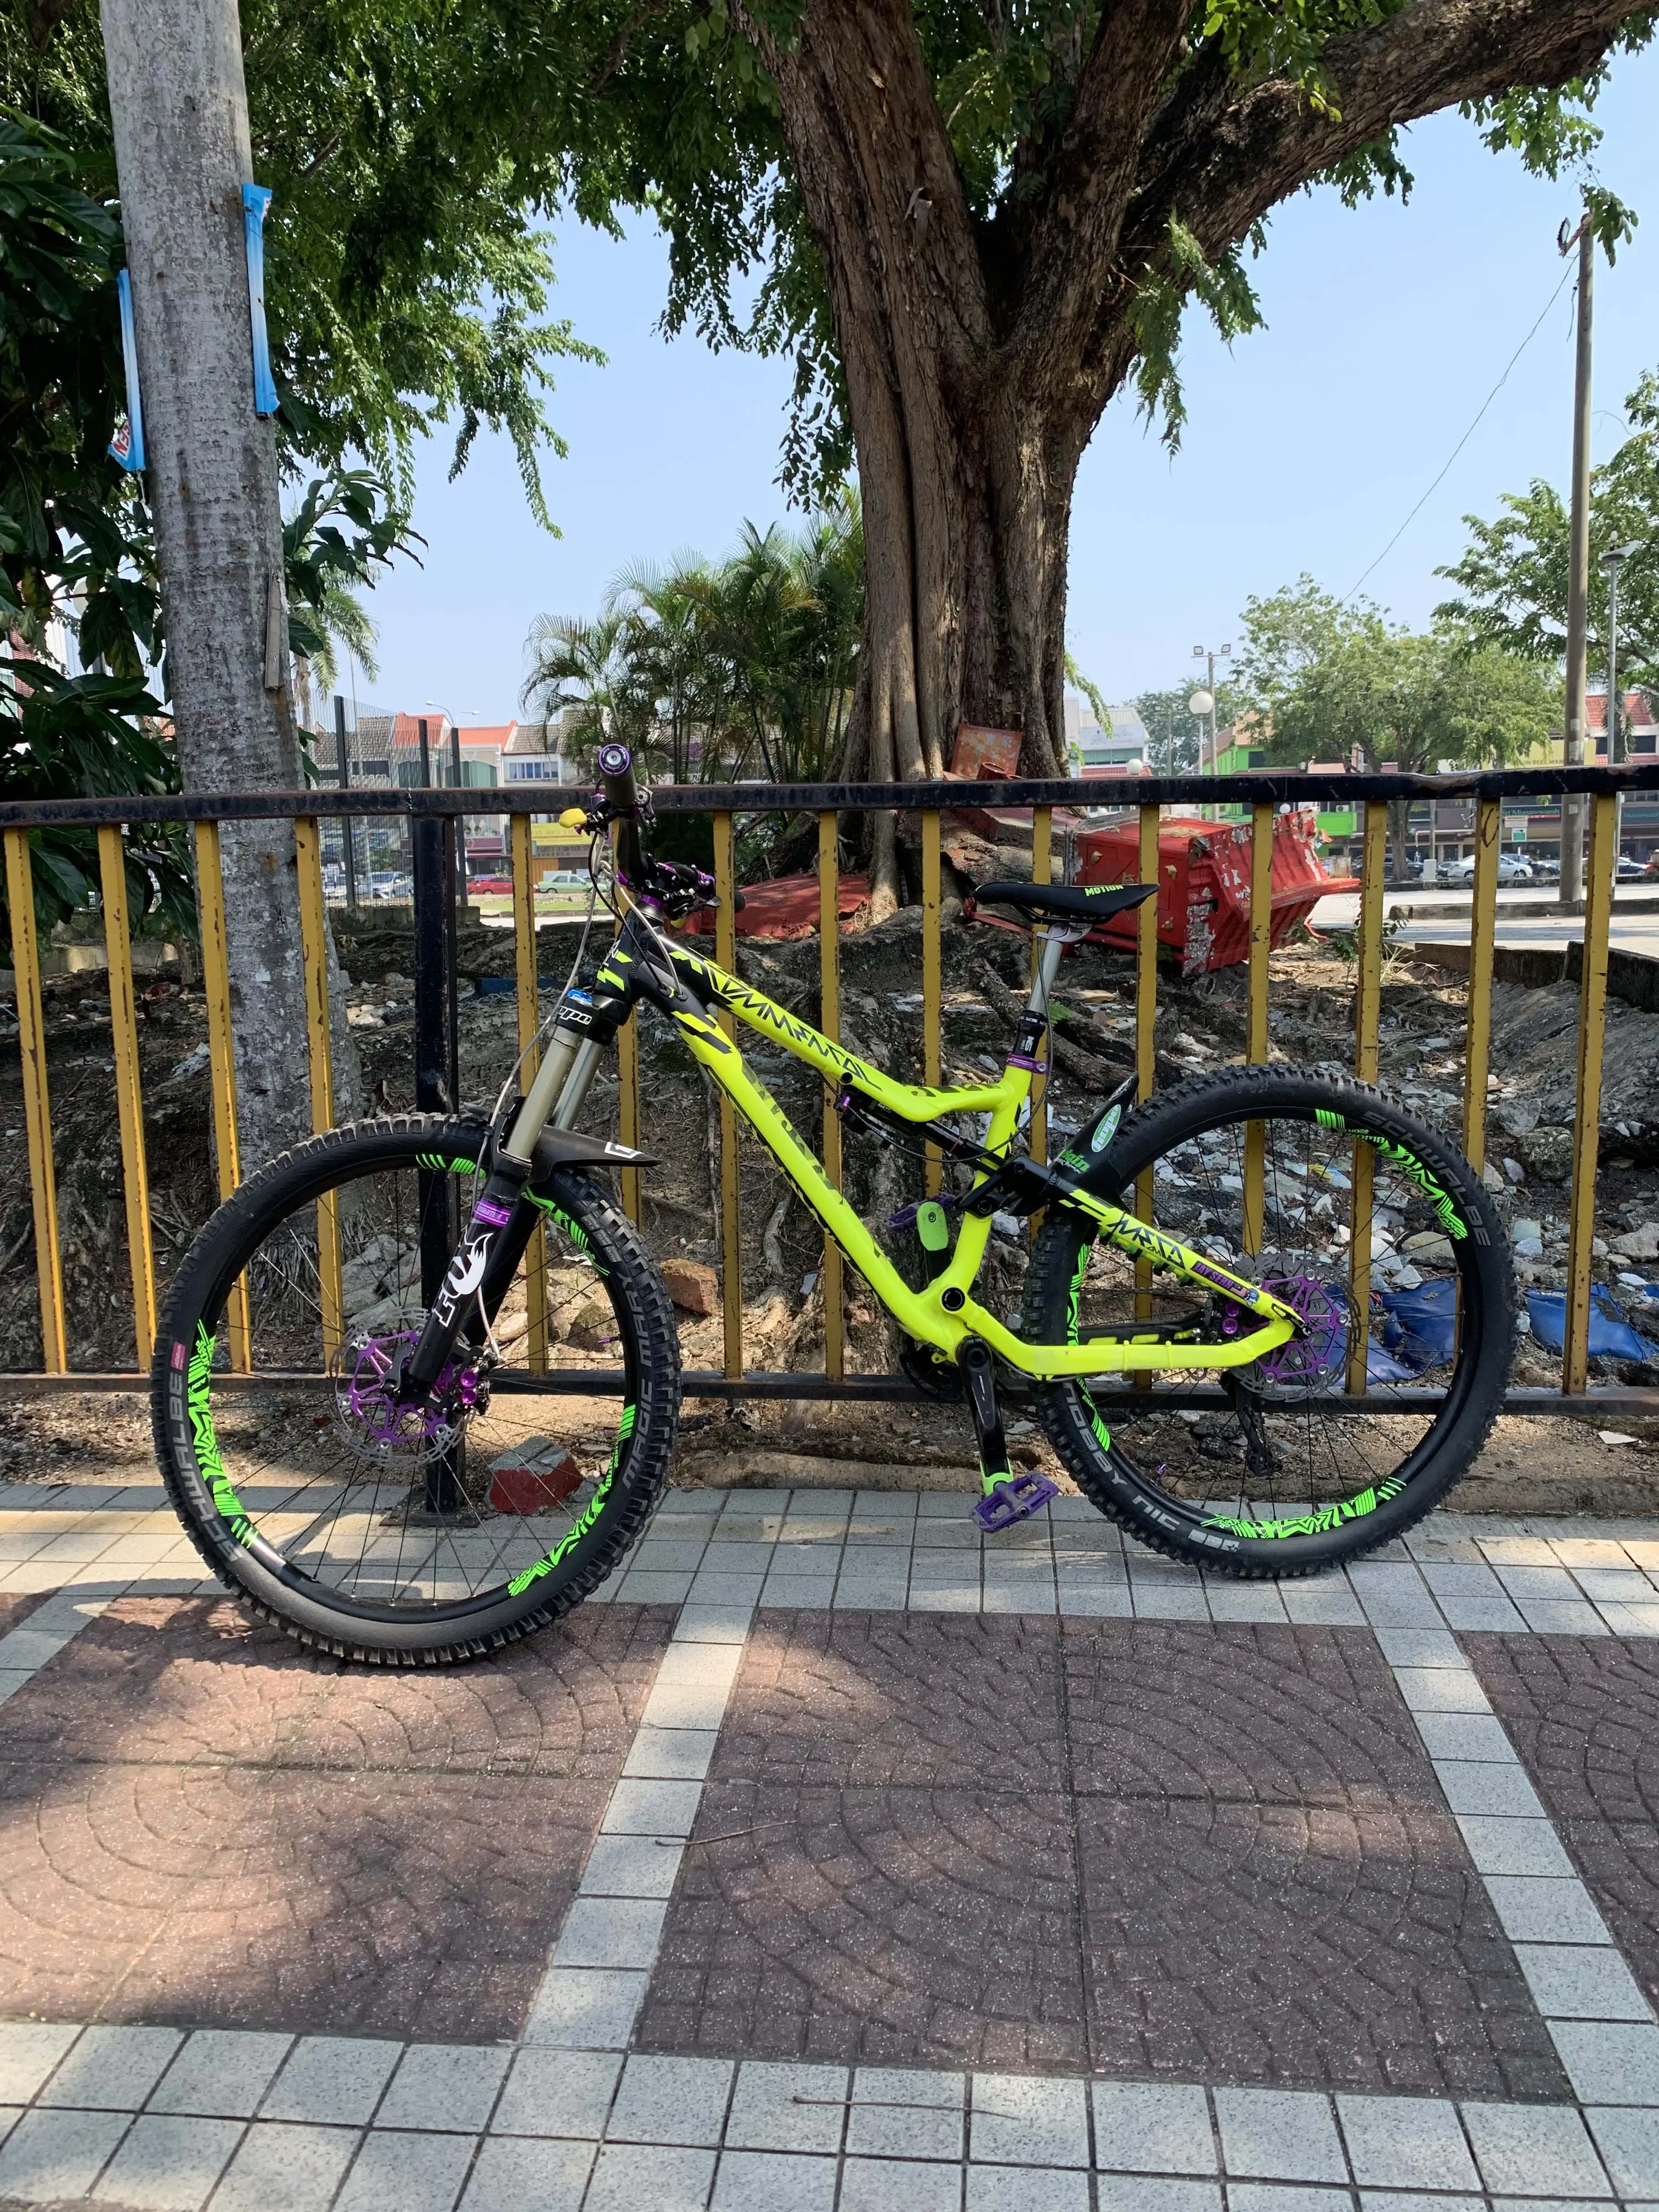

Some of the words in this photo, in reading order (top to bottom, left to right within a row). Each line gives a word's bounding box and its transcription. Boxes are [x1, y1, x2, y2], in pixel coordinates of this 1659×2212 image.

[1084, 885, 1124, 897] MOTION
[1091, 1104, 1120, 1151] hope
[1361, 1110, 1492, 1246] SCHWALBE
[617, 1272, 653, 1367] MARY
[168, 1372, 243, 1564] SCHWALBE
[622, 1379, 653, 1489] MAGIC
[1063, 1382, 1128, 1486] NOBBY
[1132, 1494, 1180, 1532] NIC
